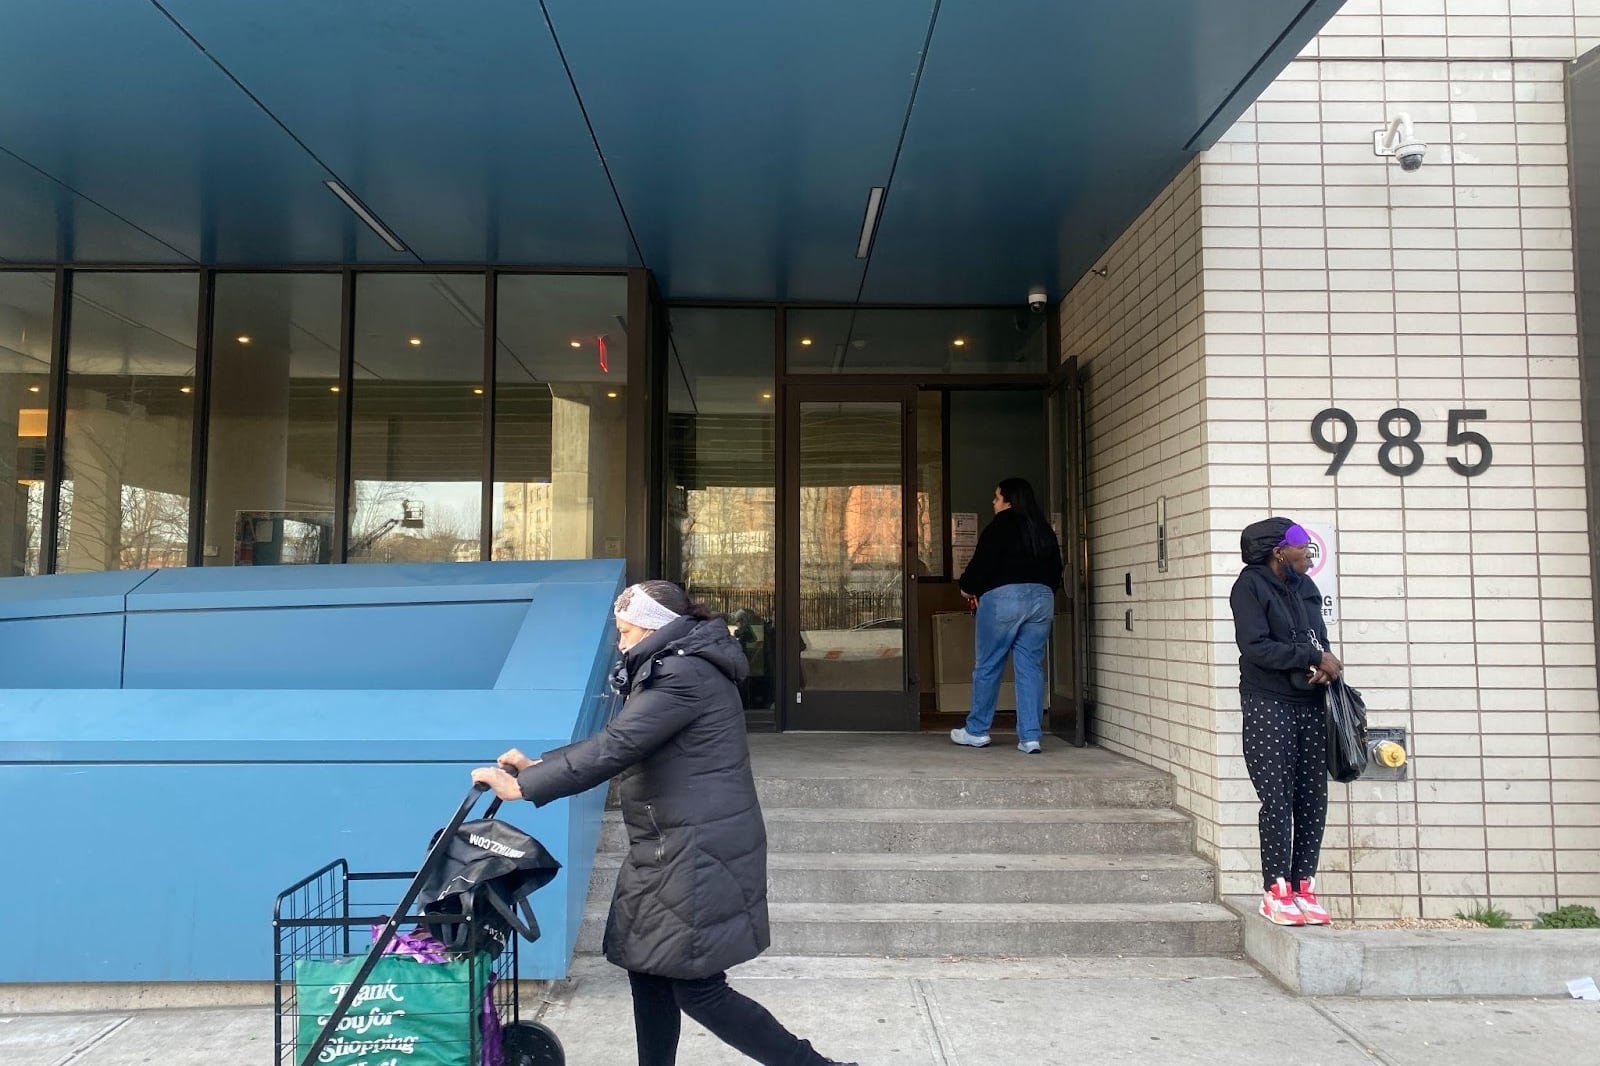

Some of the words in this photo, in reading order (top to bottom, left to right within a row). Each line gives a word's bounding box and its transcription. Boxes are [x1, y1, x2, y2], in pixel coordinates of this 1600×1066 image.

[1311, 408, 1493, 477] 985
[356, 1007, 406, 1034] for
[318, 1033, 419, 1063] Shopping
